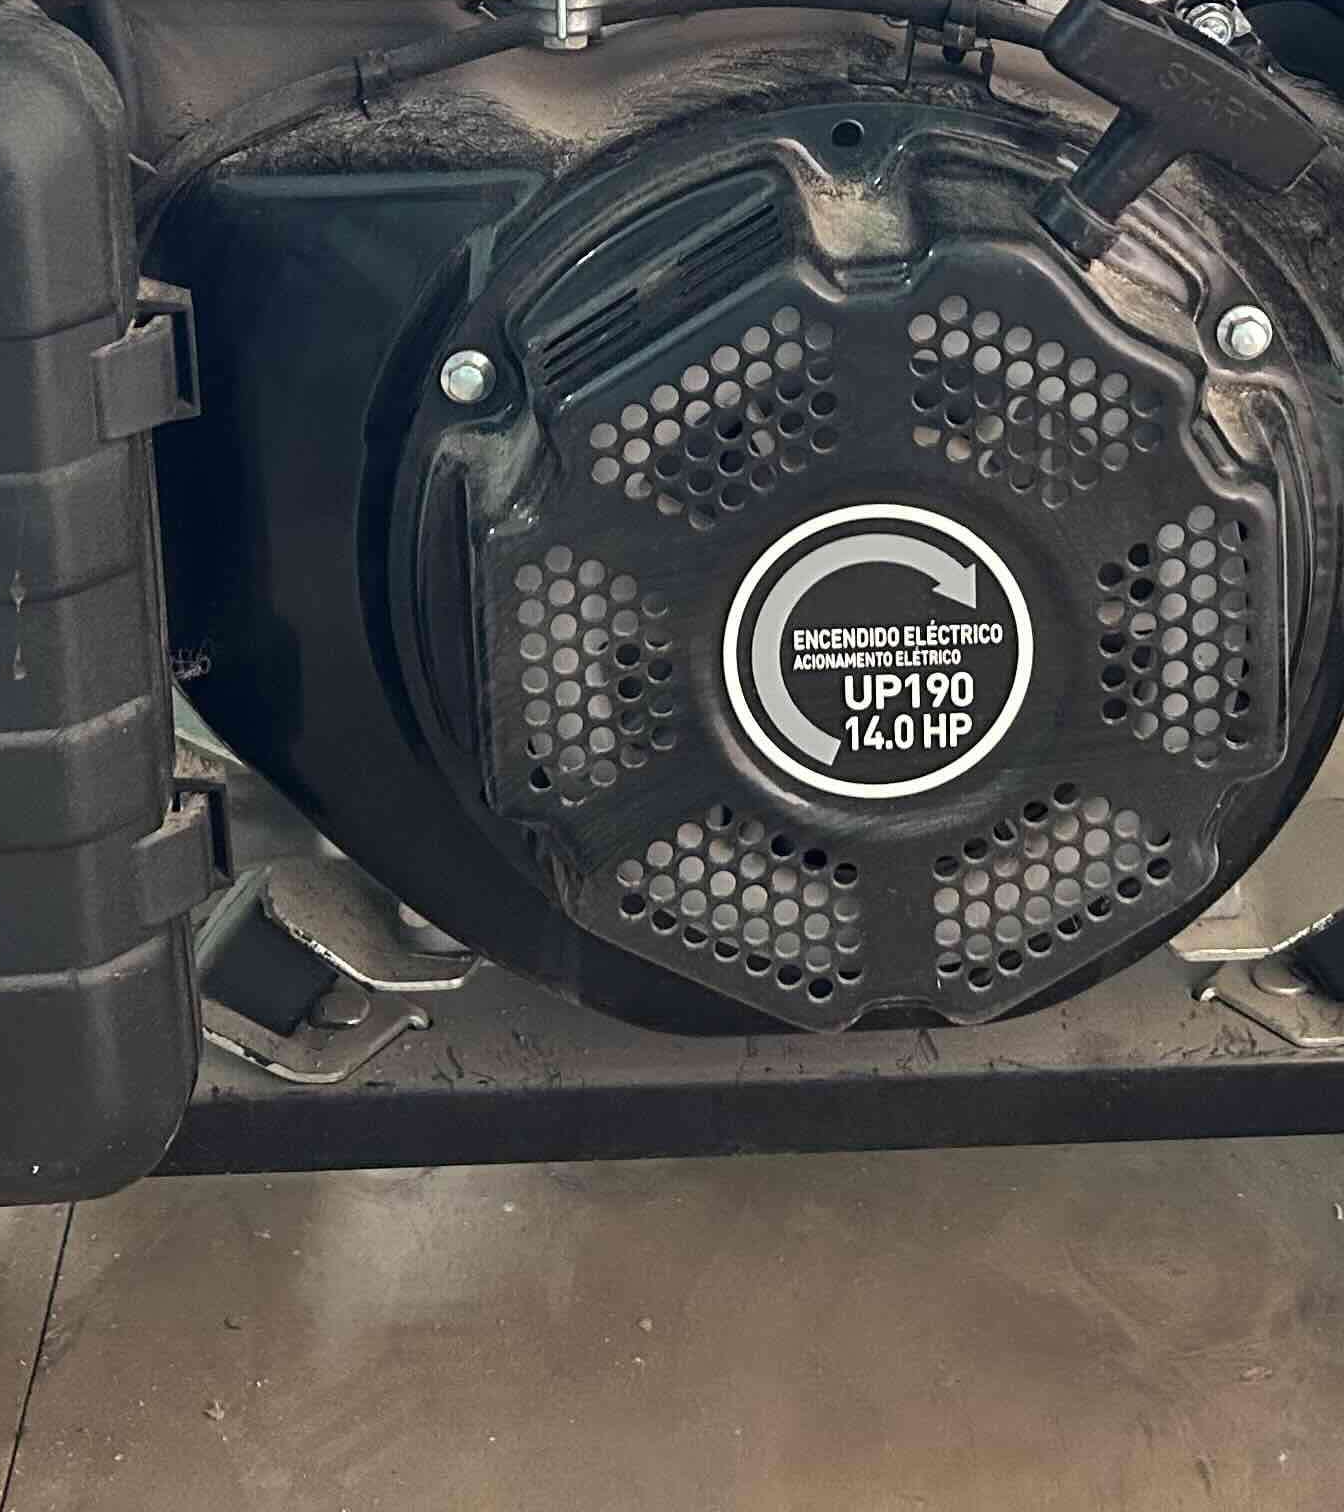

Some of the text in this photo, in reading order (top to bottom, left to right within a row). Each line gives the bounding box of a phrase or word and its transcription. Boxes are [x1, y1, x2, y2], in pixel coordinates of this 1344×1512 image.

[1159, 61, 1268, 130] START
[793, 620, 1003, 651] ENCENDIDO ELÉCTRICO
[793, 646, 962, 671] ACIONAMENTO ELÉTRICO
[844, 671, 974, 711] UP190
[844, 712, 973, 751] 14.0 HP
